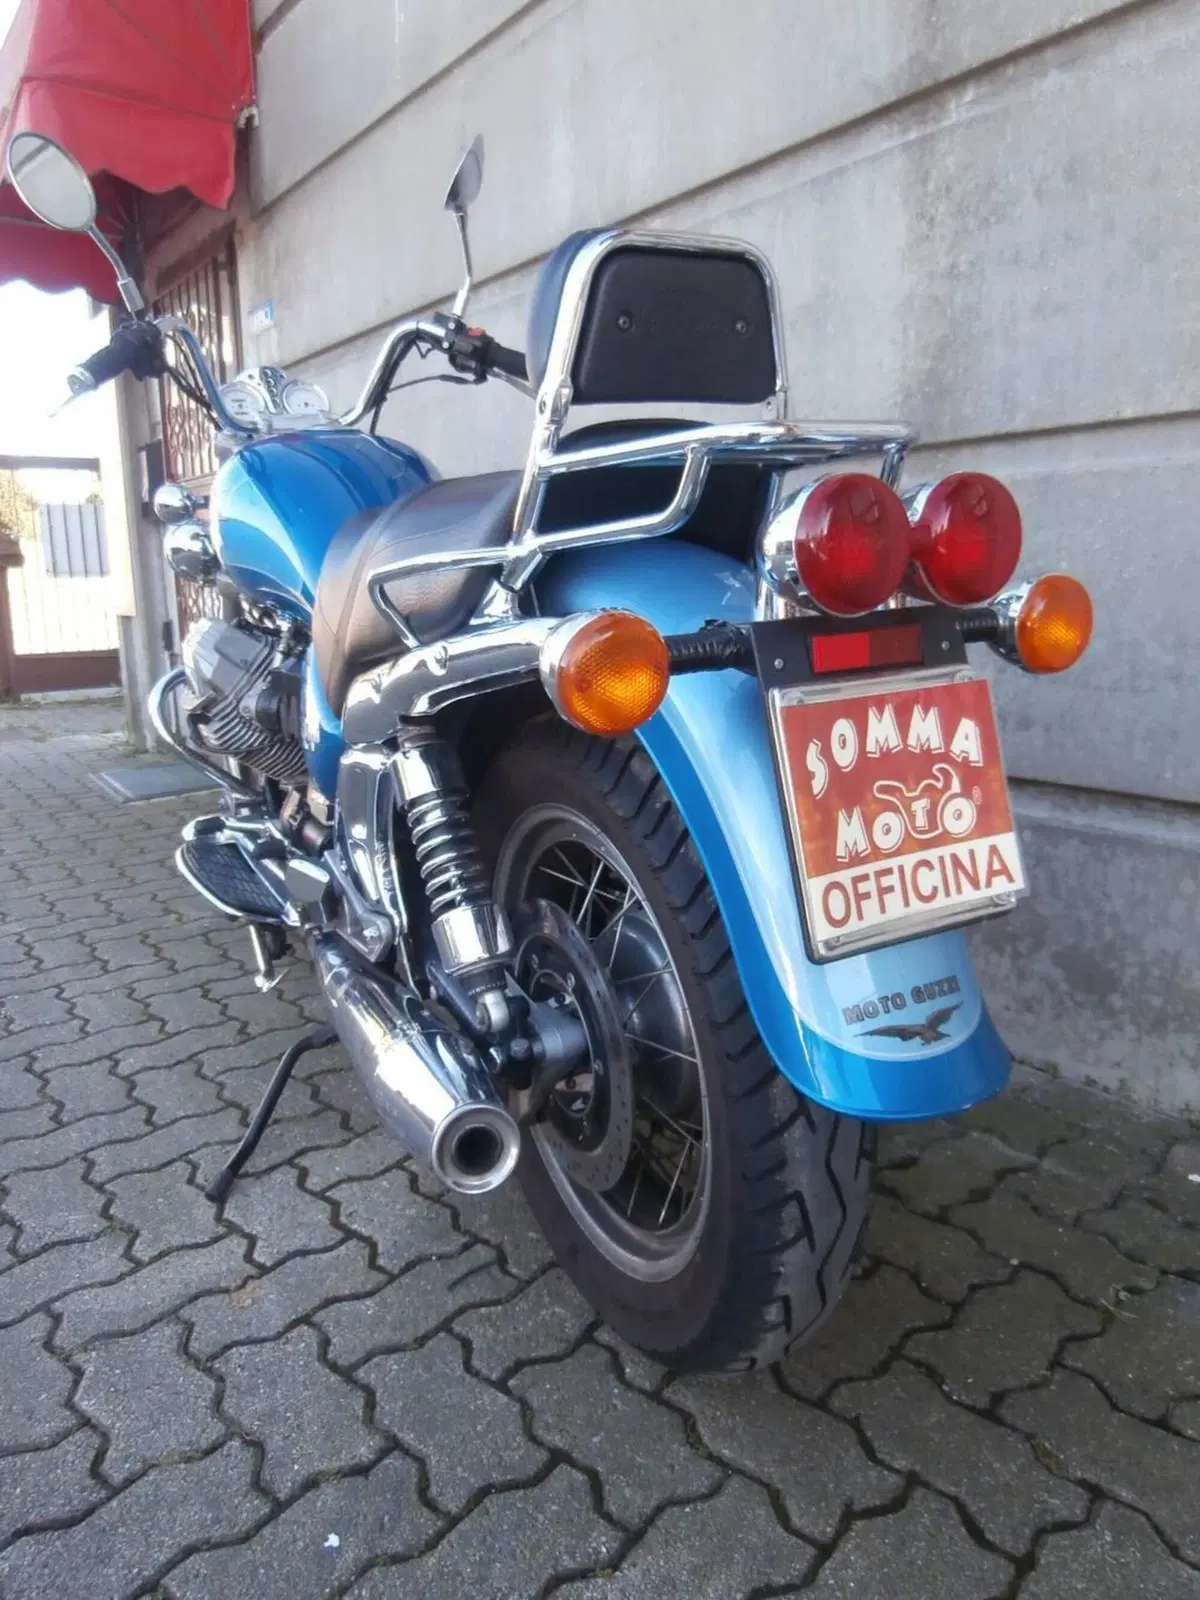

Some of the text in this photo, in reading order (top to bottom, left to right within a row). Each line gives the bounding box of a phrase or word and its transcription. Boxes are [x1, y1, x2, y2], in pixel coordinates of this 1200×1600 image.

[805, 703, 983, 800] SOMMA
[836, 796, 976, 862] MOTO
[822, 844, 1015, 928] OFFICINA
[842, 992, 906, 1025] MOTO
